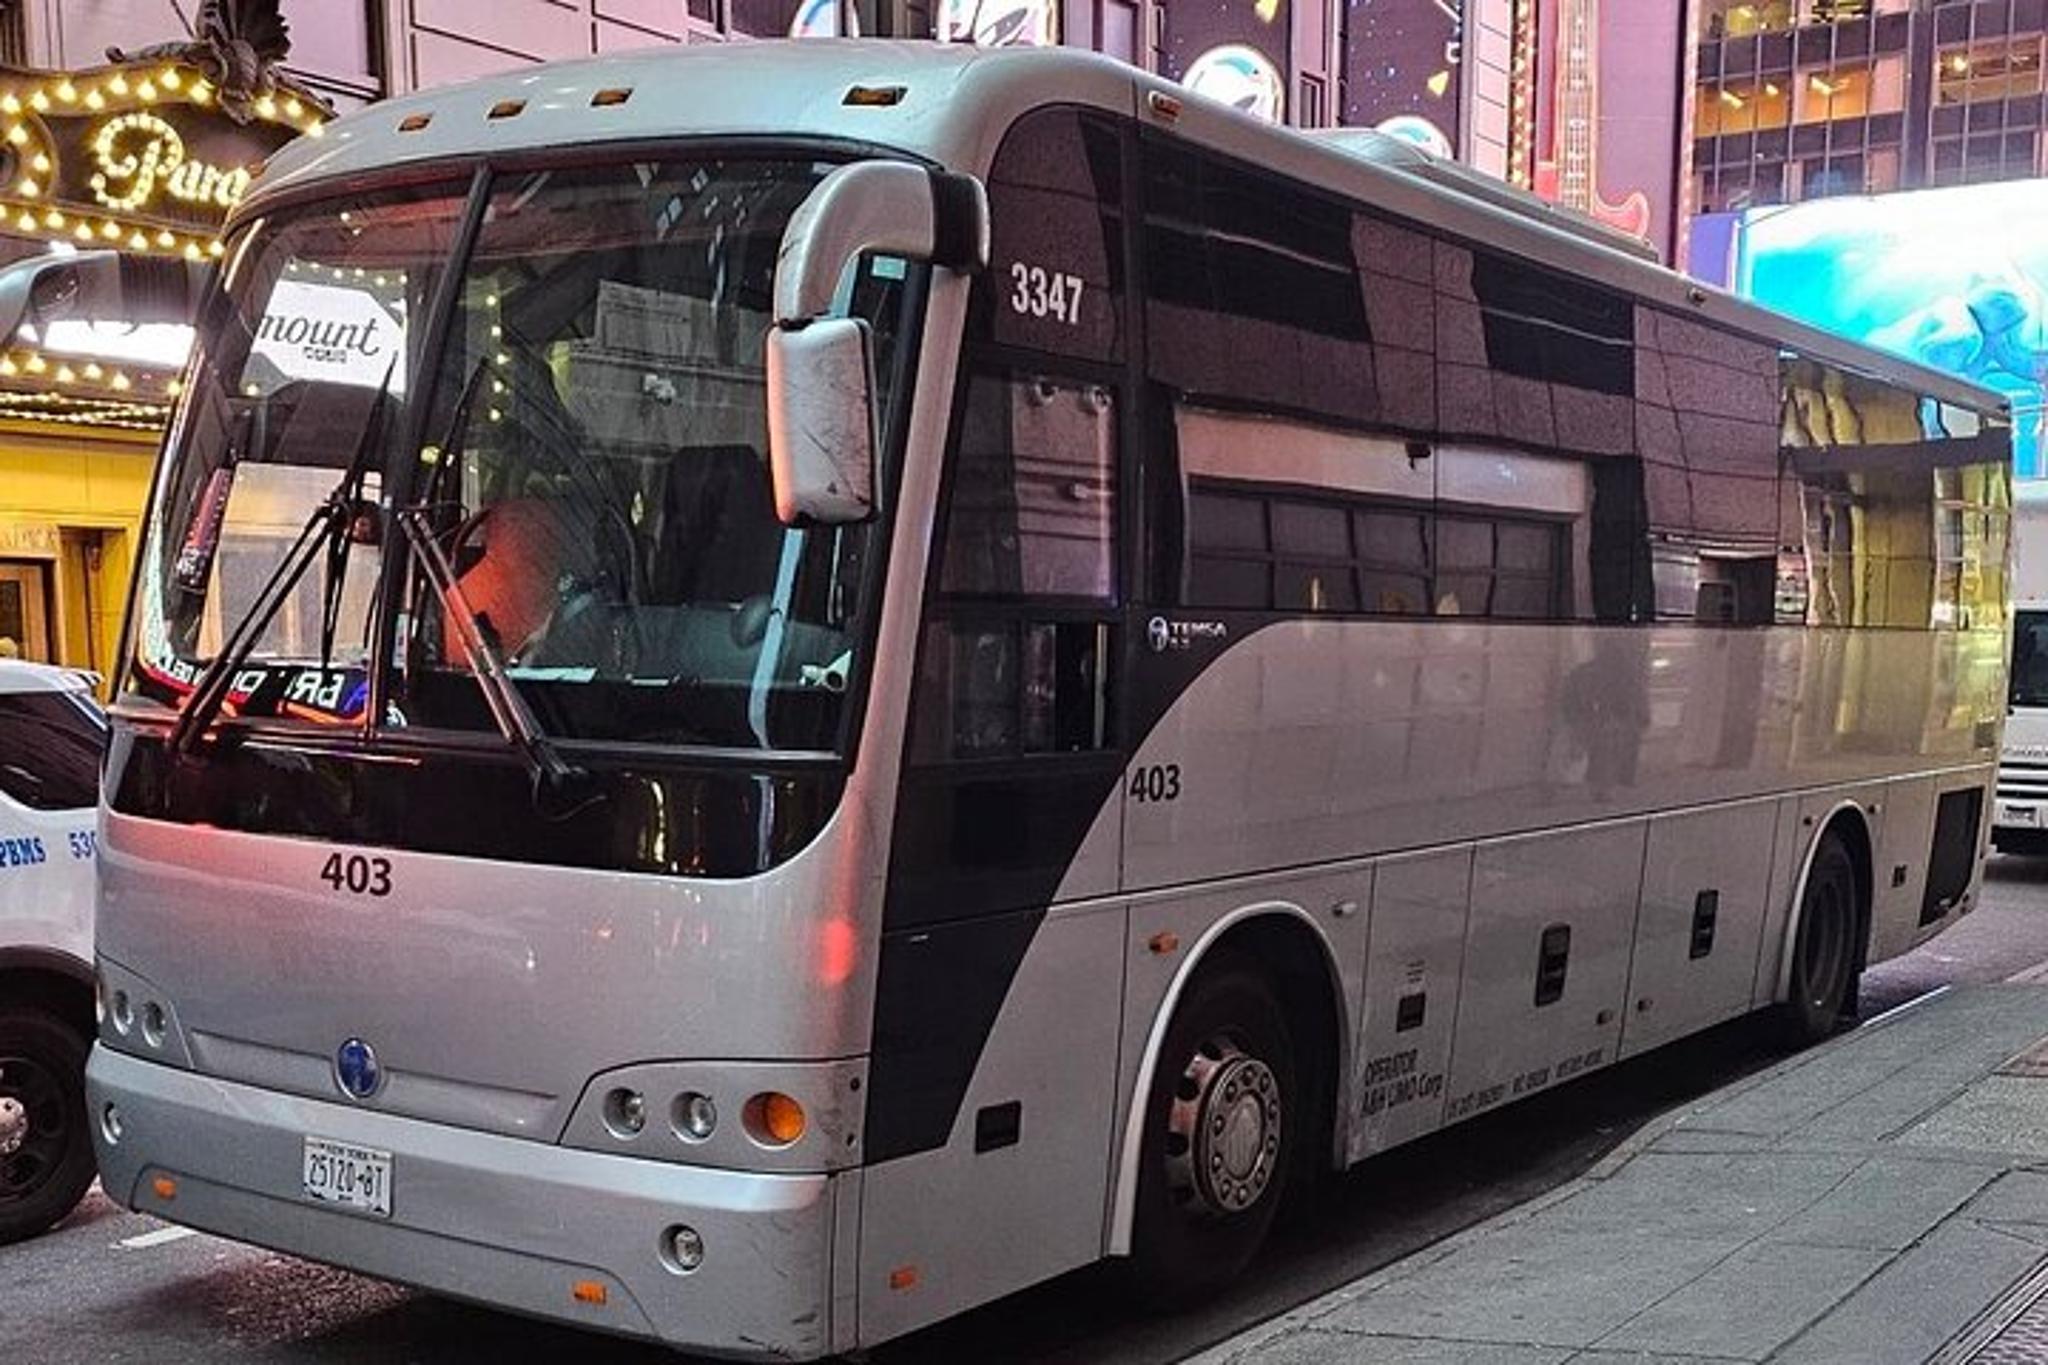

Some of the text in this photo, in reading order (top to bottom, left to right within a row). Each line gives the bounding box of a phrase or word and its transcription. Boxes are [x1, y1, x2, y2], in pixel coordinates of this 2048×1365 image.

[1011, 261, 1083, 325] 3347
[1129, 764, 1180, 802] 403
[320, 852, 392, 897] 403
